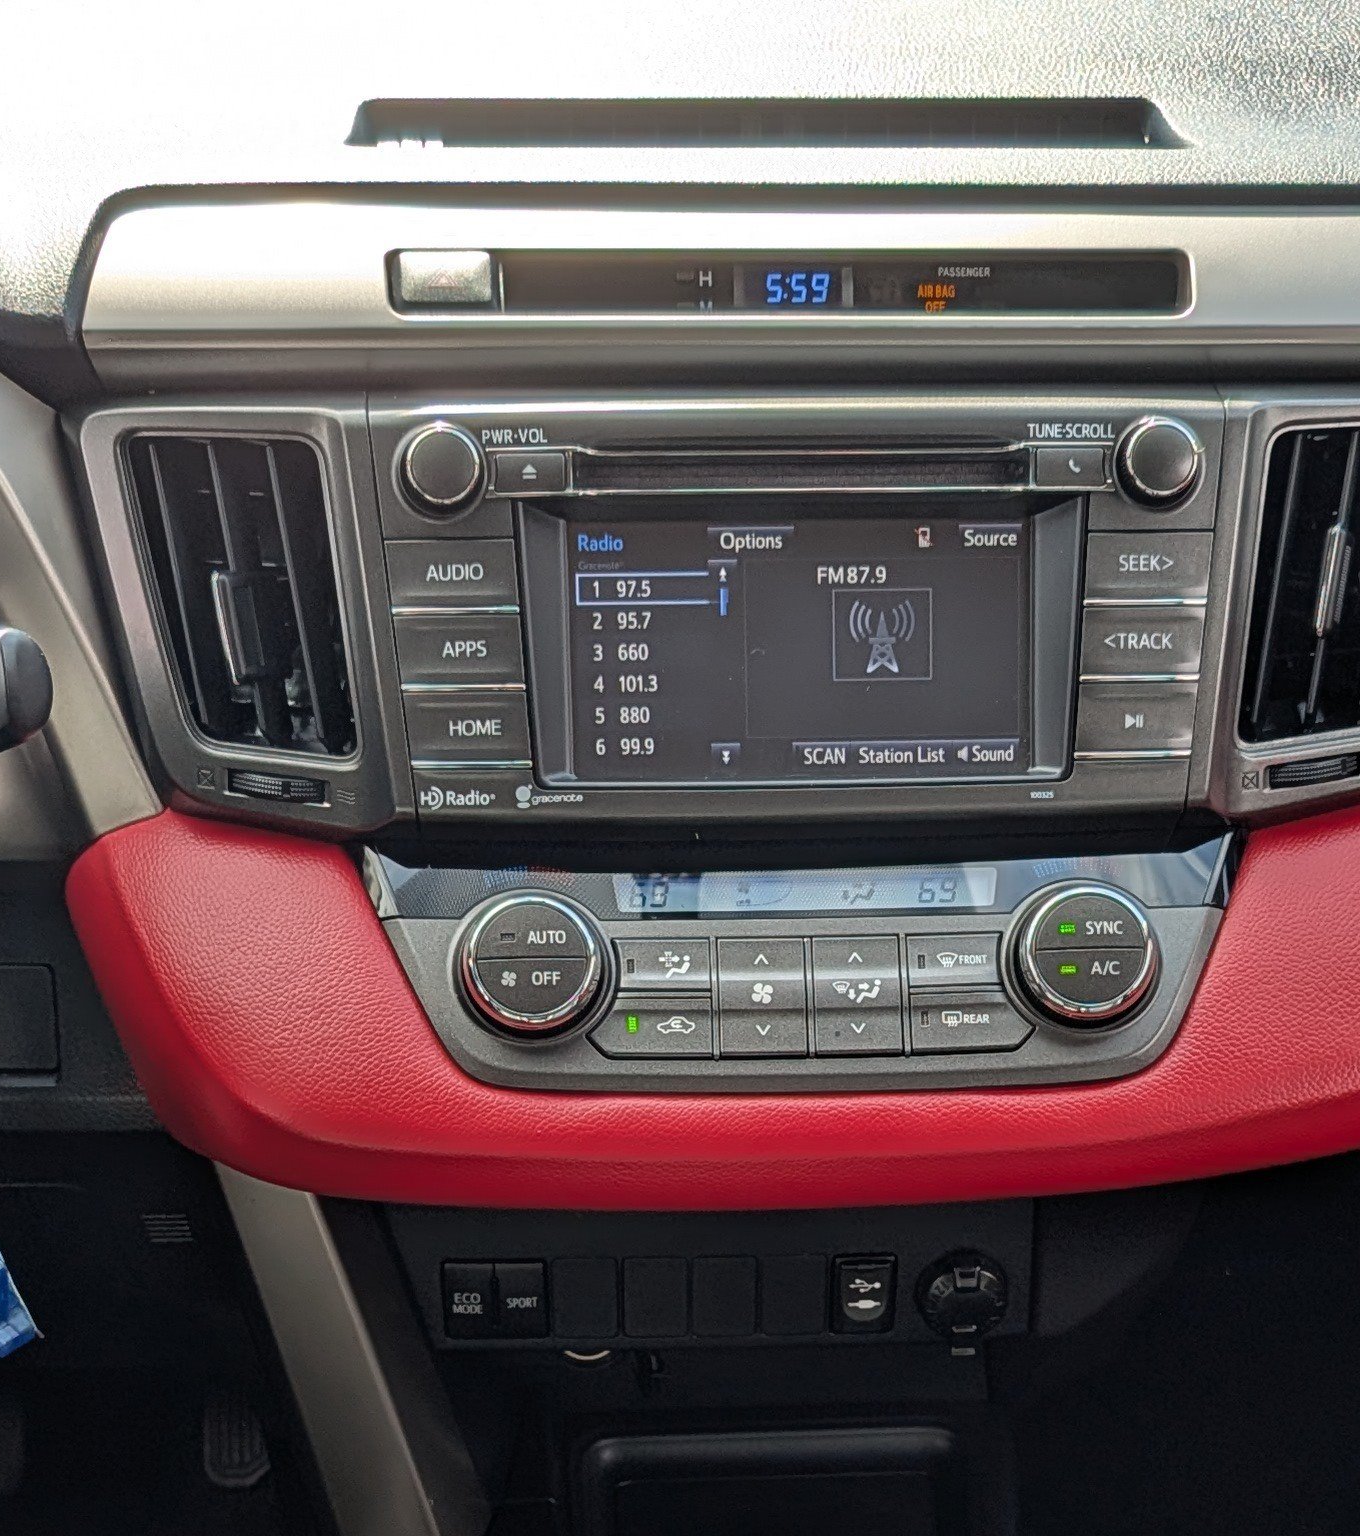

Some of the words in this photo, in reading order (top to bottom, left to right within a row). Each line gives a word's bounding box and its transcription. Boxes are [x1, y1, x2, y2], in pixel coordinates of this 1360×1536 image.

[699, 270, 712, 287] H
[938, 266, 990, 278] PASSENGER
[766, 273, 830, 304] 5:59
[917, 284, 934, 298] AIR
[935, 284, 956, 298] BAG
[924, 301, 947, 314] OFF
[577, 533, 624, 552] Radio
[719, 532, 783, 553] Options
[964, 529, 1019, 547] Source
[425, 562, 484, 582] AUDIO
[592, 580, 600, 599] 1
[616, 579, 652, 599] 97.5
[592, 611, 603, 630] 2
[617, 611, 652, 630] 95.7
[442, 640, 488, 659] APPS
[593, 643, 604, 662] 3
[617, 643, 650, 662] 660
[593, 674, 605, 694] 4
[618, 674, 659, 693] 101.3
[594, 707, 606, 725] 5
[619, 706, 651, 725] 880
[448, 719, 502, 737] HOME
[595, 738, 607, 756] 6
[620, 737, 655, 756] 99.9
[858, 746, 914, 764] Station
[917, 746, 946, 764] List
[971, 745, 1015, 763] Sound
[803, 747, 846, 765] SCAN
[918, 877, 957, 904] 69
[1085, 920, 1124, 936] SYNC
[527, 930, 567, 946] AUTO
[959, 954, 988, 966] FRONT
[1091, 960, 1121, 976] A/C
[531, 971, 561, 986] OFF
[963, 1013, 990, 1025] REAR
[454, 1292, 481, 1304] ECO
[506, 1296, 538, 1309] SPORT
[452, 1304, 484, 1315] MODE
